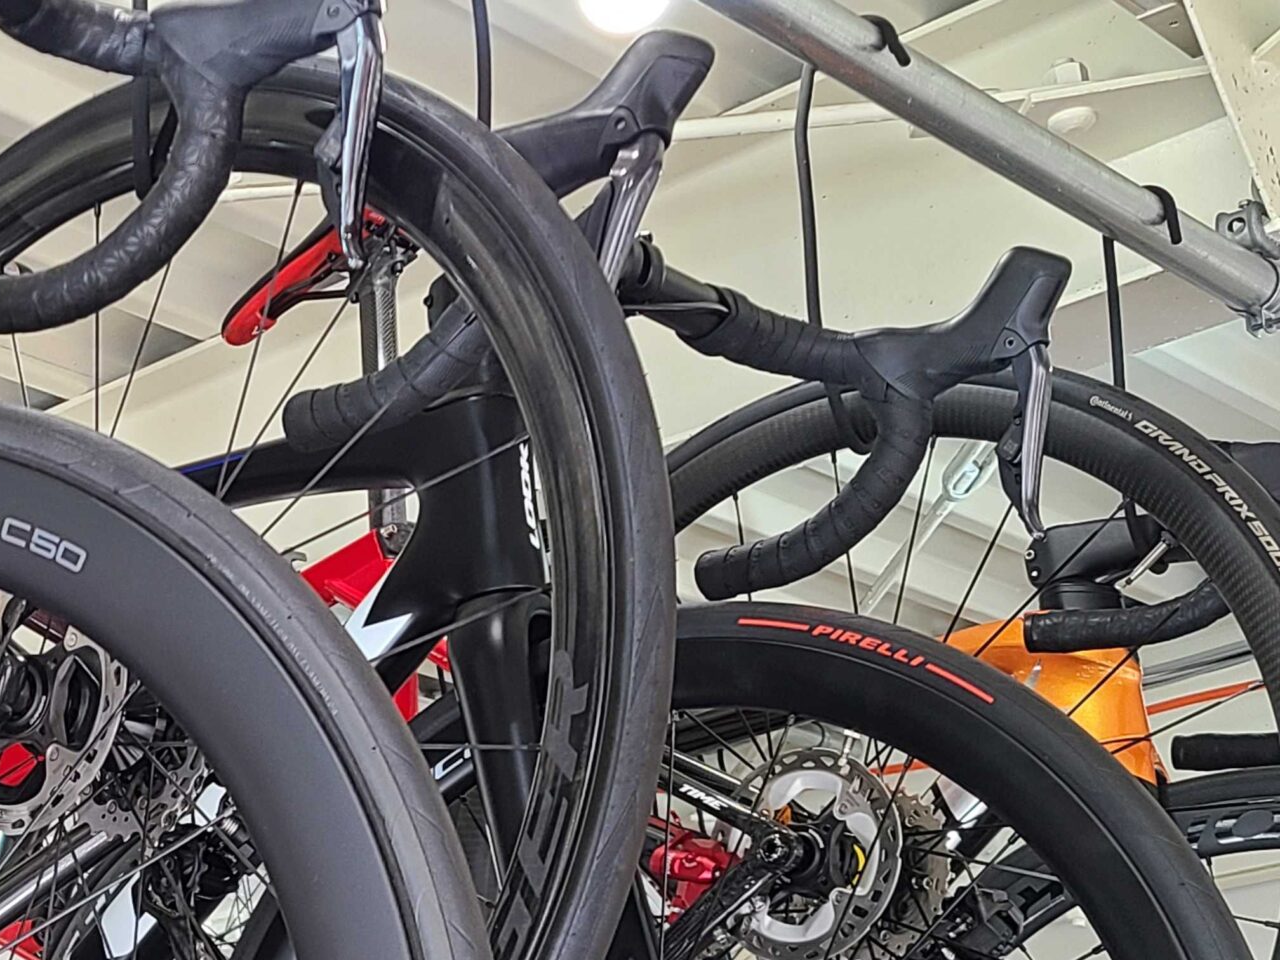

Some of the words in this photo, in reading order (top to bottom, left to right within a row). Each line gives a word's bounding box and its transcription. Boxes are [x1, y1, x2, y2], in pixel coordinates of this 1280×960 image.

[519, 442, 540, 550] LOOK
[1134, 420, 1212, 475] GRAND
[1204, 473, 1256, 520] PRIX
[0, 517, 88, 574] C50
[811, 624, 926, 667] PIRELLI
